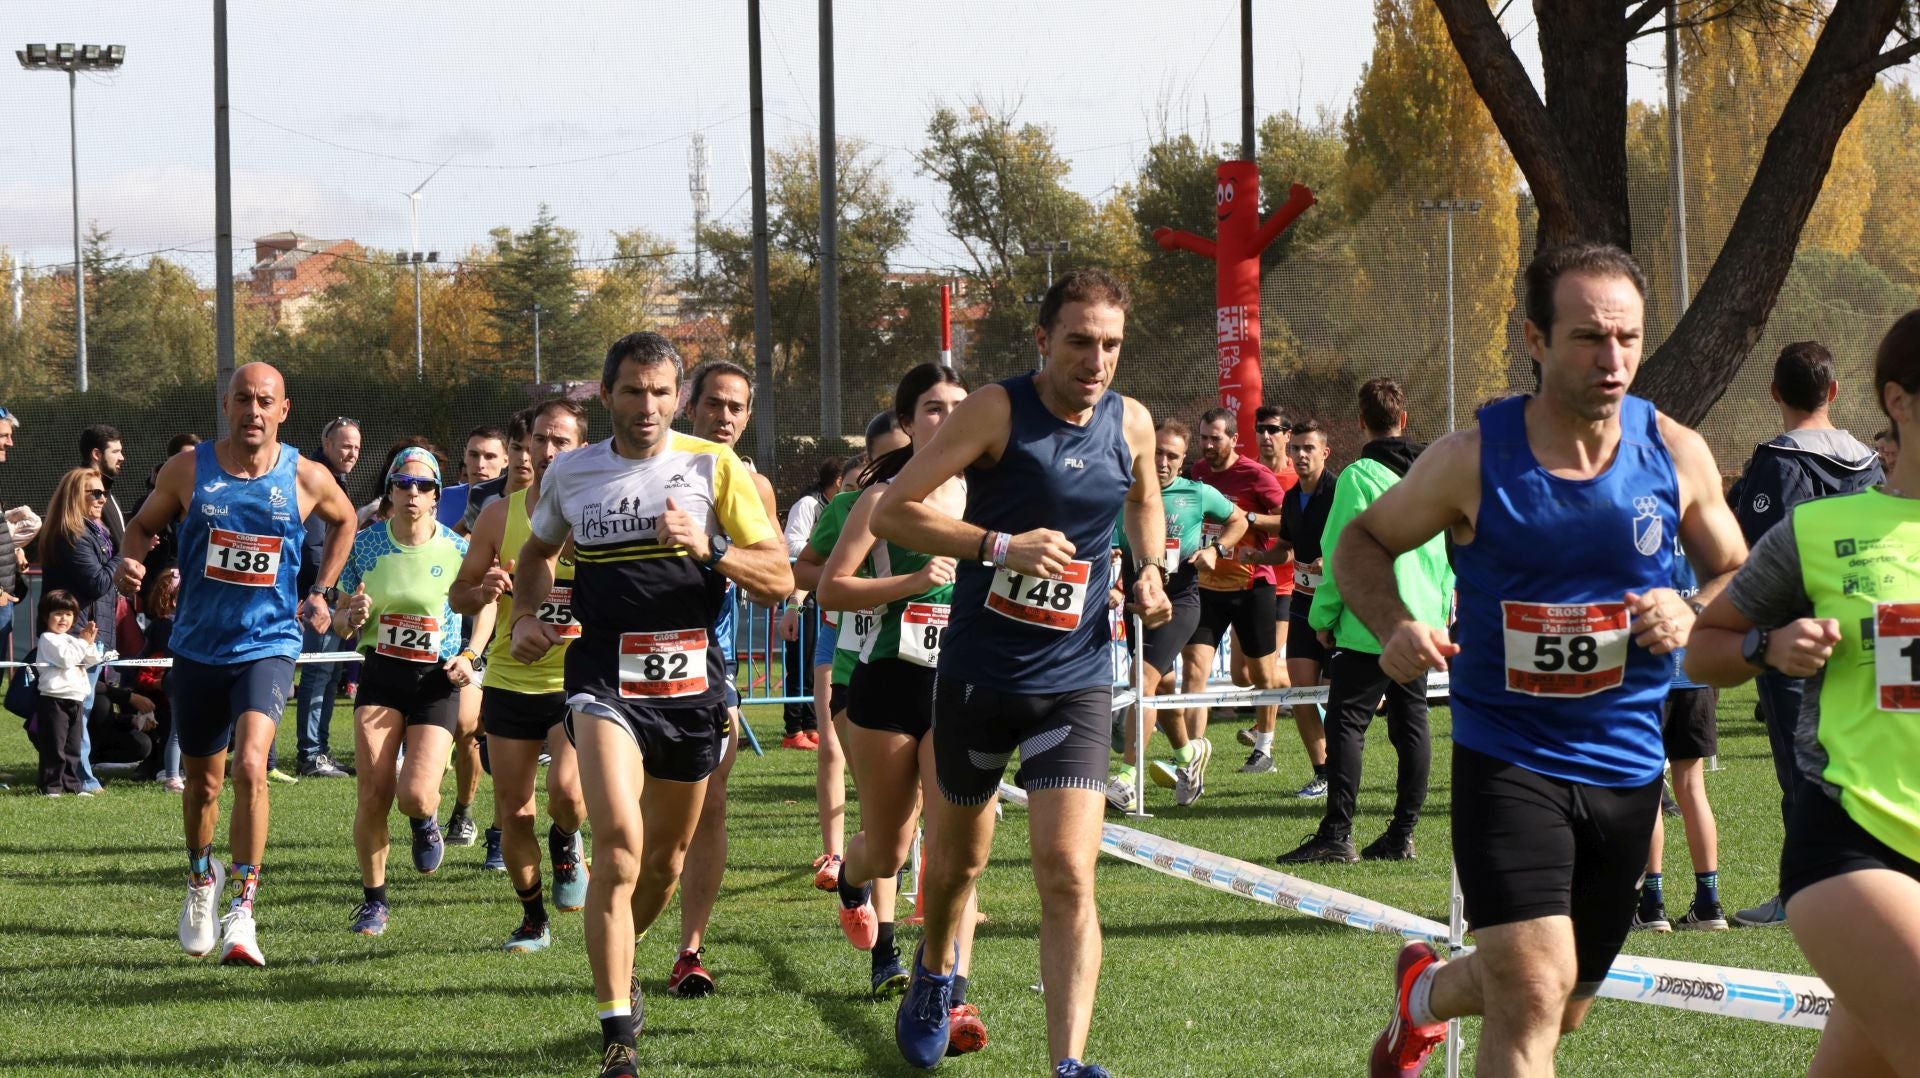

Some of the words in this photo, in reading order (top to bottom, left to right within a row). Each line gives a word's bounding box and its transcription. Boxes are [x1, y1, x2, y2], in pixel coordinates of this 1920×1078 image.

[1064, 458, 1084, 468] FILA
[236, 534, 258, 542] CROSS
[232, 542, 260, 551] Palencia
[218, 548, 270, 573] 138
[1302, 573, 1309, 586] 3
[1008, 574, 1074, 610] 148
[539, 603, 572, 624] 25
[1547, 607, 1587, 616] CROSS
[400, 621, 423, 630] Palencia
[1542, 623, 1593, 633] Palencia
[387, 627, 431, 649] 124
[653, 633, 679, 641] CROSS
[650, 644, 685, 653] Palencia
[1533, 636, 1598, 672] 58
[643, 653, 688, 680] 82
[1652, 972, 1725, 1002] plaspisa
